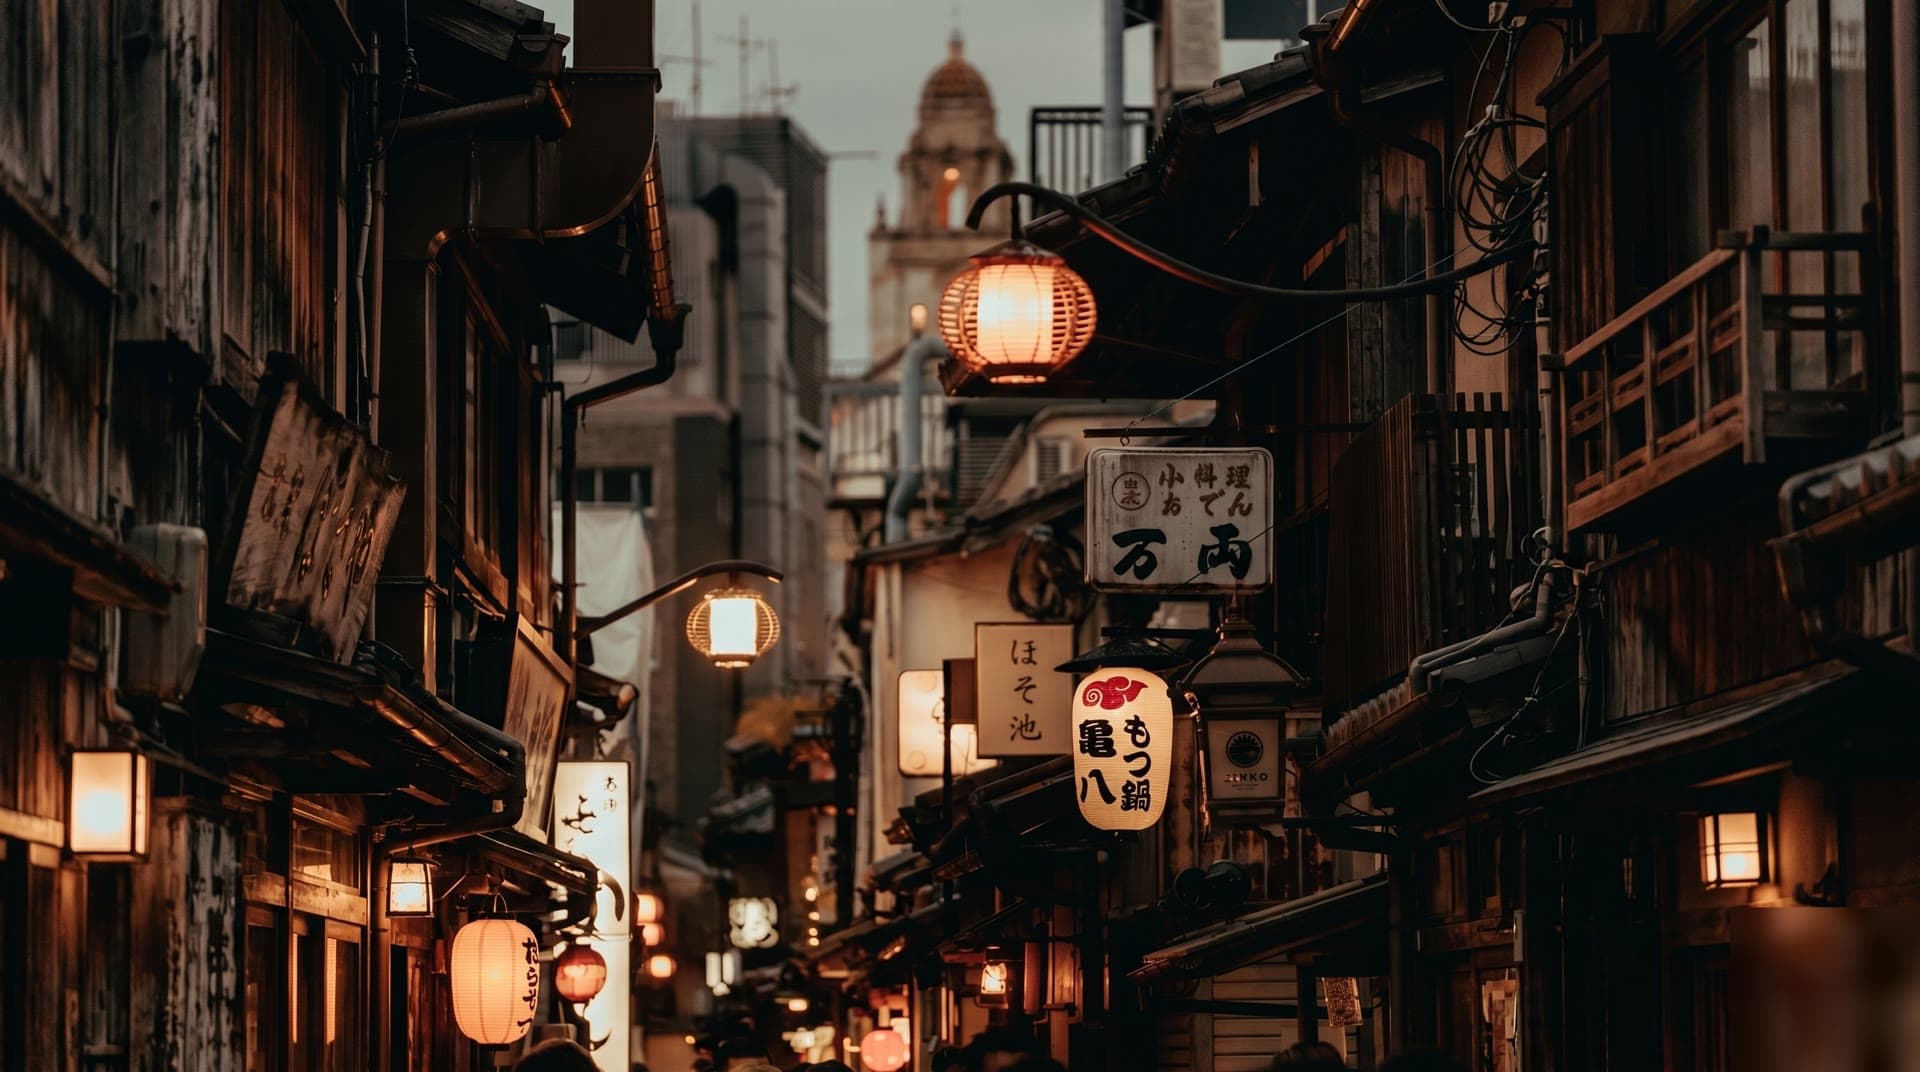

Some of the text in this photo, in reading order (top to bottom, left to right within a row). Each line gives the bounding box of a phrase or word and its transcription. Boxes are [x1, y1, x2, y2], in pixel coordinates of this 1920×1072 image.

[1158, 462, 1251, 489] 小料理
[1161, 489, 1253, 517] おでん
[1112, 523, 1252, 581] 万両
[1010, 639, 1042, 742] ほそ池
[1079, 719, 1117, 805] 亀八
[1121, 714, 1152, 812] もつ鍋
